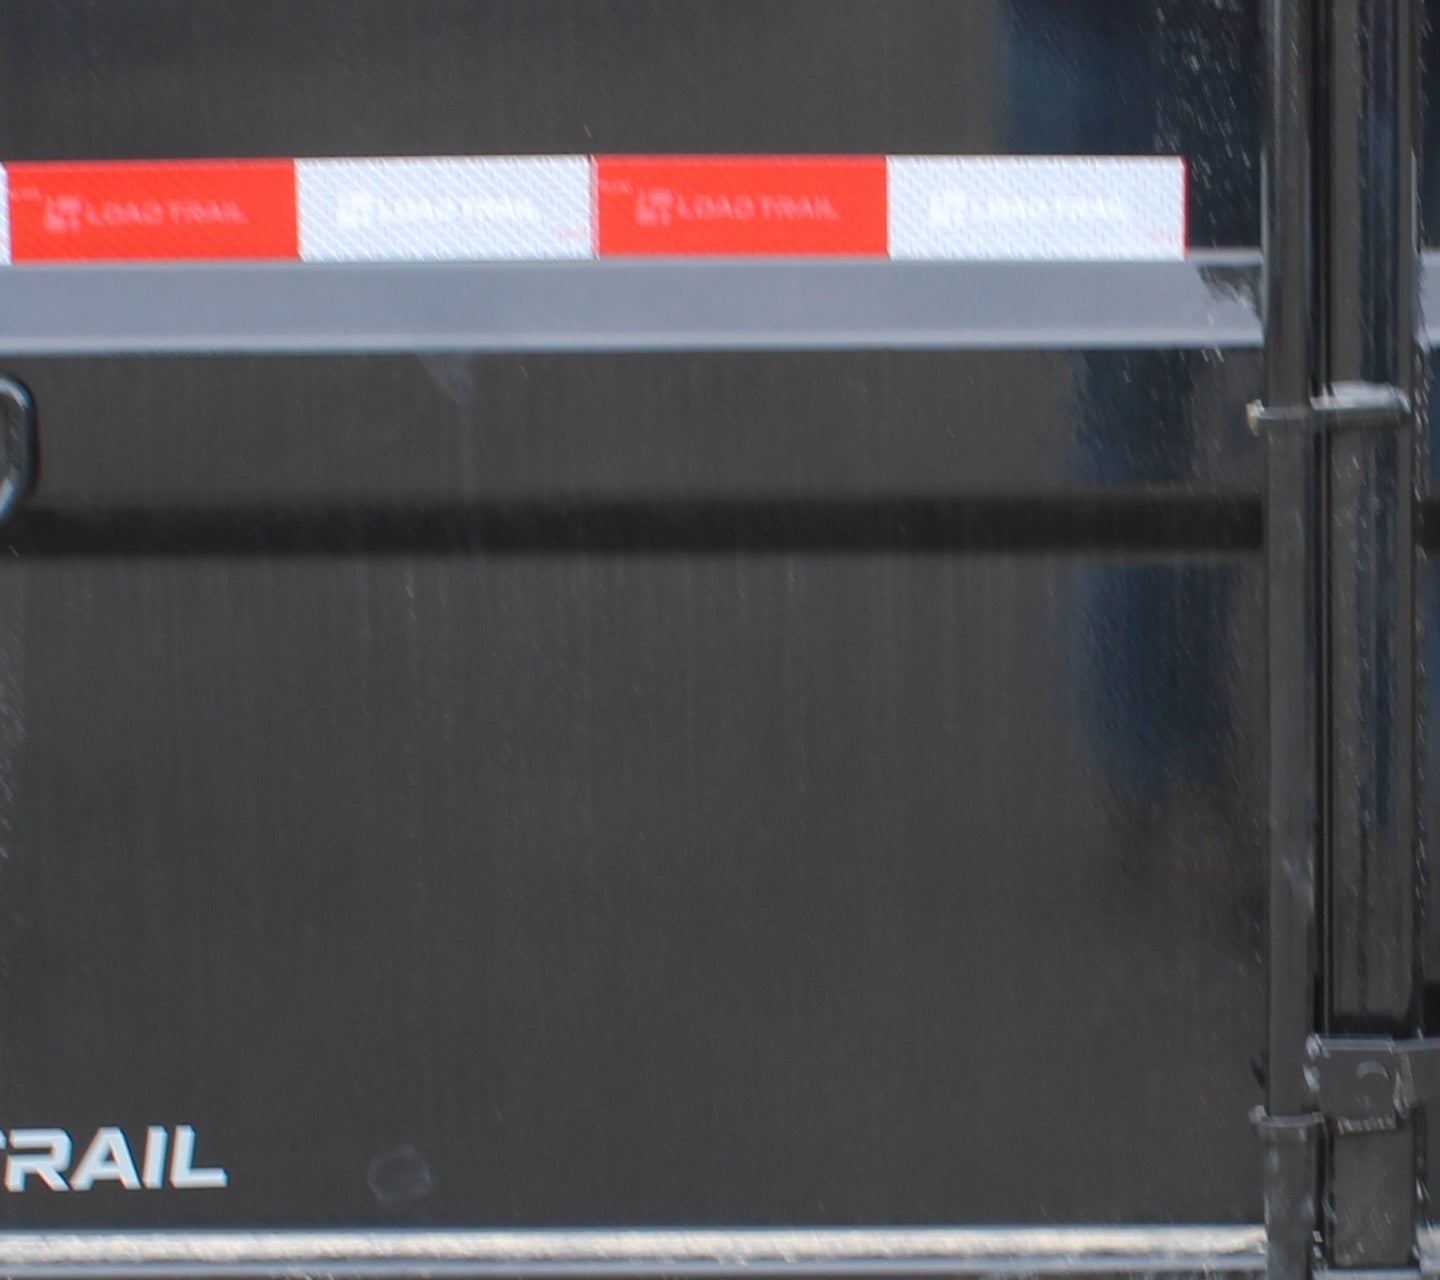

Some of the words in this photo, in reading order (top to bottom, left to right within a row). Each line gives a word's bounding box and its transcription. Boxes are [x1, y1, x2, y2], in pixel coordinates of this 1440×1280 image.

[87, 202, 164, 227] LOAD
[168, 200, 247, 225] TRAIL
[678, 196, 754, 222] LOAD
[760, 196, 839, 221] TRAIL
